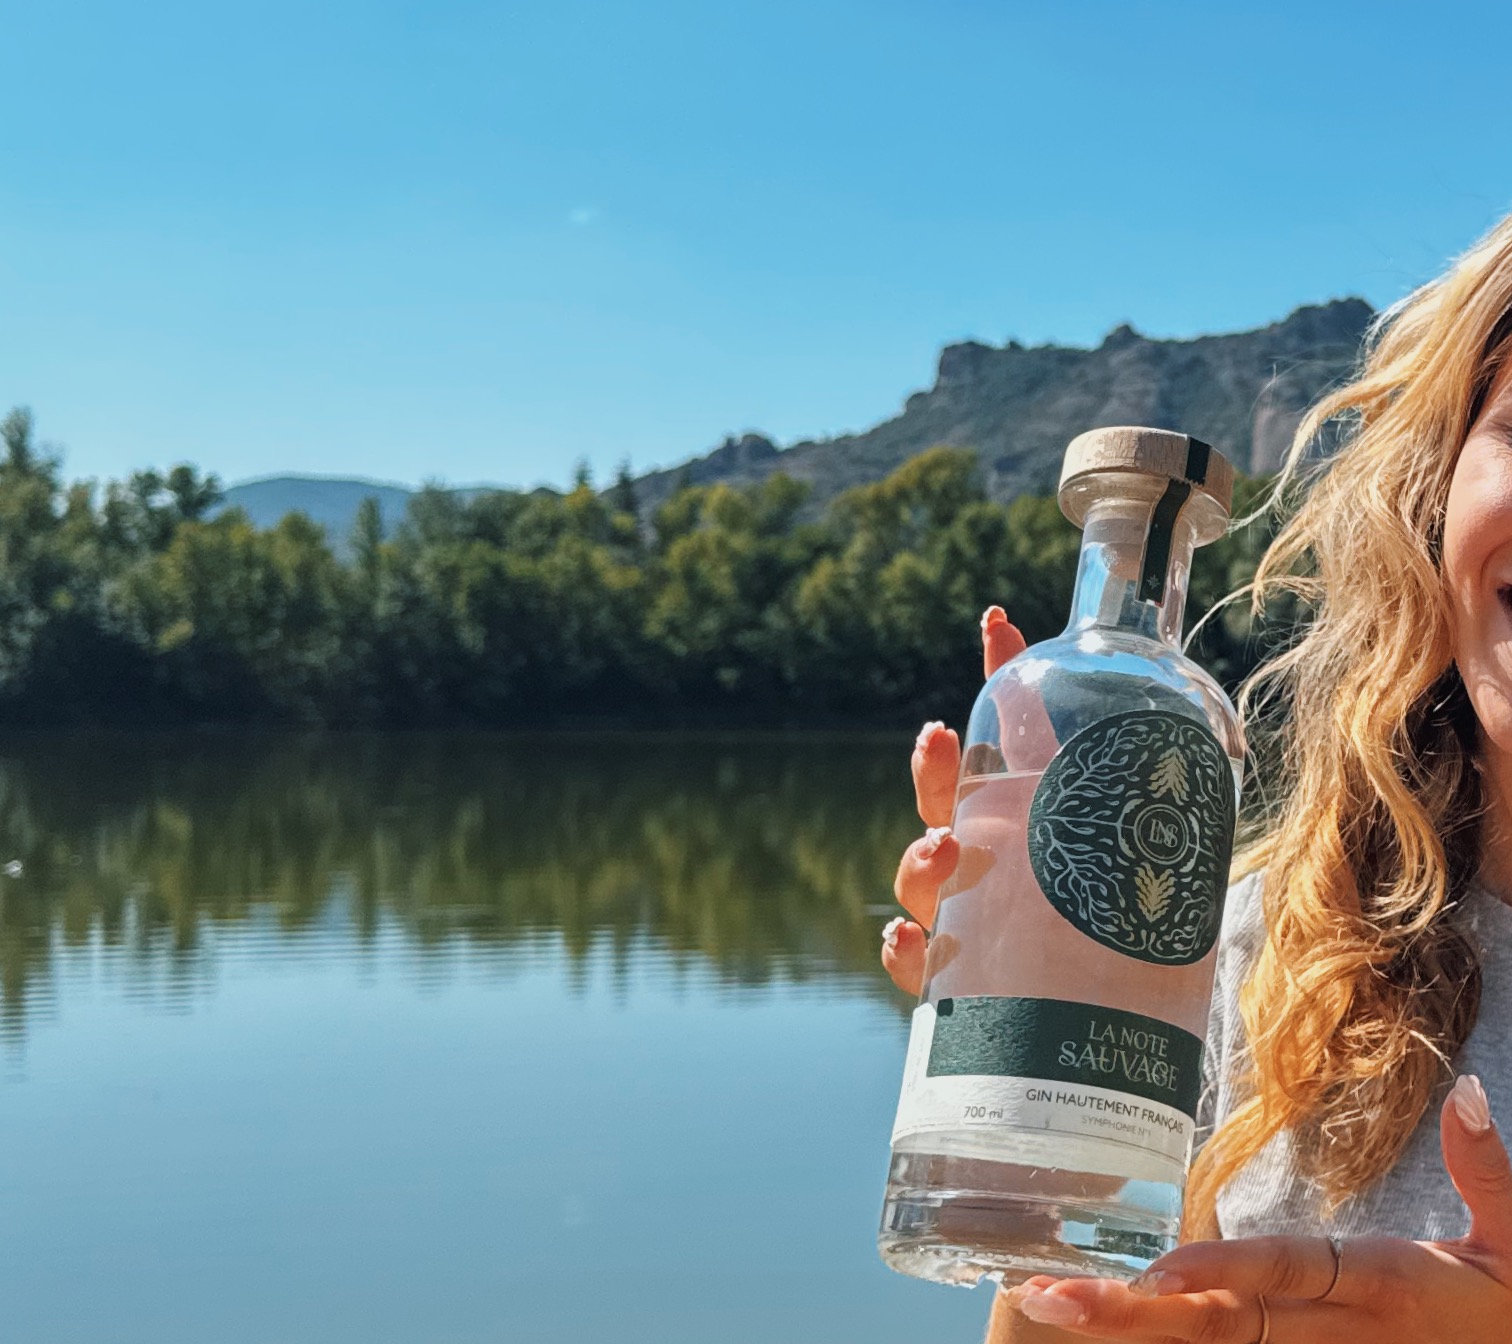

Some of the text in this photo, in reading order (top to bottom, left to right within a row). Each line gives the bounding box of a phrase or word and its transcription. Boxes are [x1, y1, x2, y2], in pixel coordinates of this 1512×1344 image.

[1088, 1020, 1169, 1057] LA NOTE
[1058, 1040, 1179, 1092] SAUVAGE
[963, 1106, 1004, 1119] 700 ml
[1026, 1088, 1184, 1134] GIN HAUTEMENT FRANÇAIS
